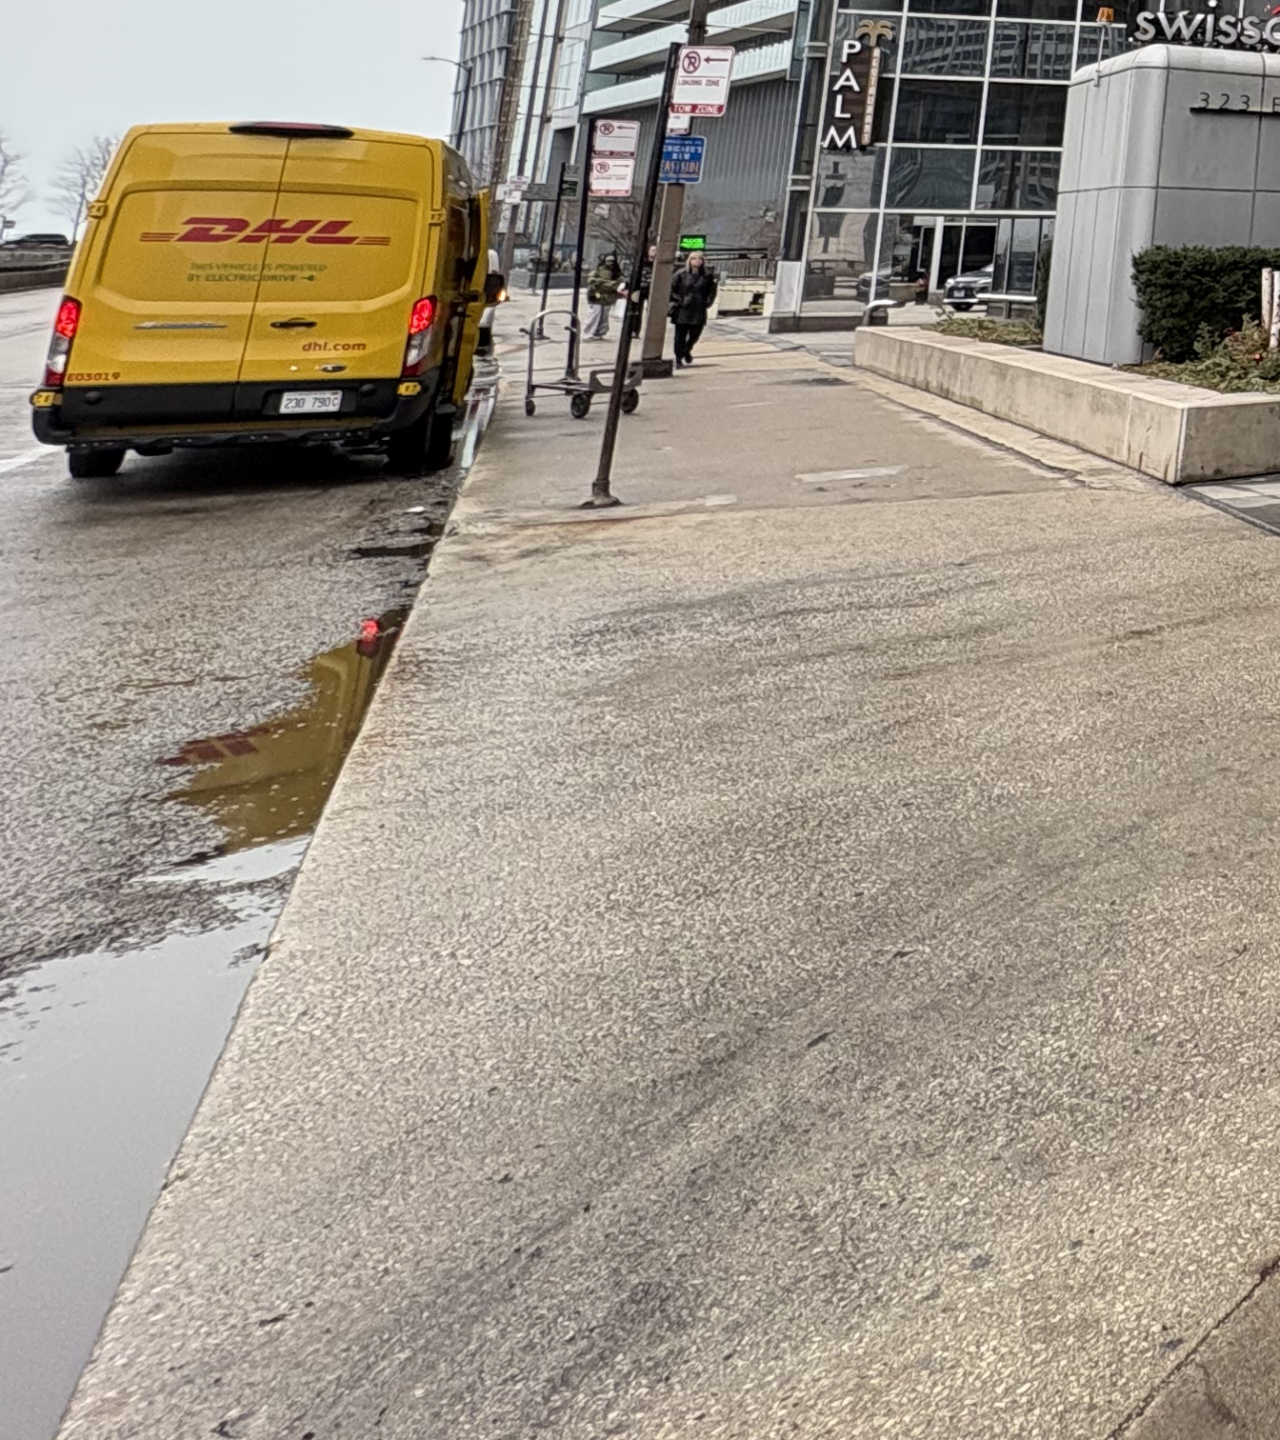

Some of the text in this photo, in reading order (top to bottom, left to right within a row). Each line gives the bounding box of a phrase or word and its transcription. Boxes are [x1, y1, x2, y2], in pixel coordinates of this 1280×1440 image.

[705, 79, 721, 87] ZONE
[823, 40, 861, 148] PALM
[1200, 92, 1251, 111] 323
[673, 105, 720, 114] TOW ZONE
[174, 216, 358, 245] DHL
[262, 274, 297, 282] DRIVE
[302, 342, 366, 352] dhl.com
